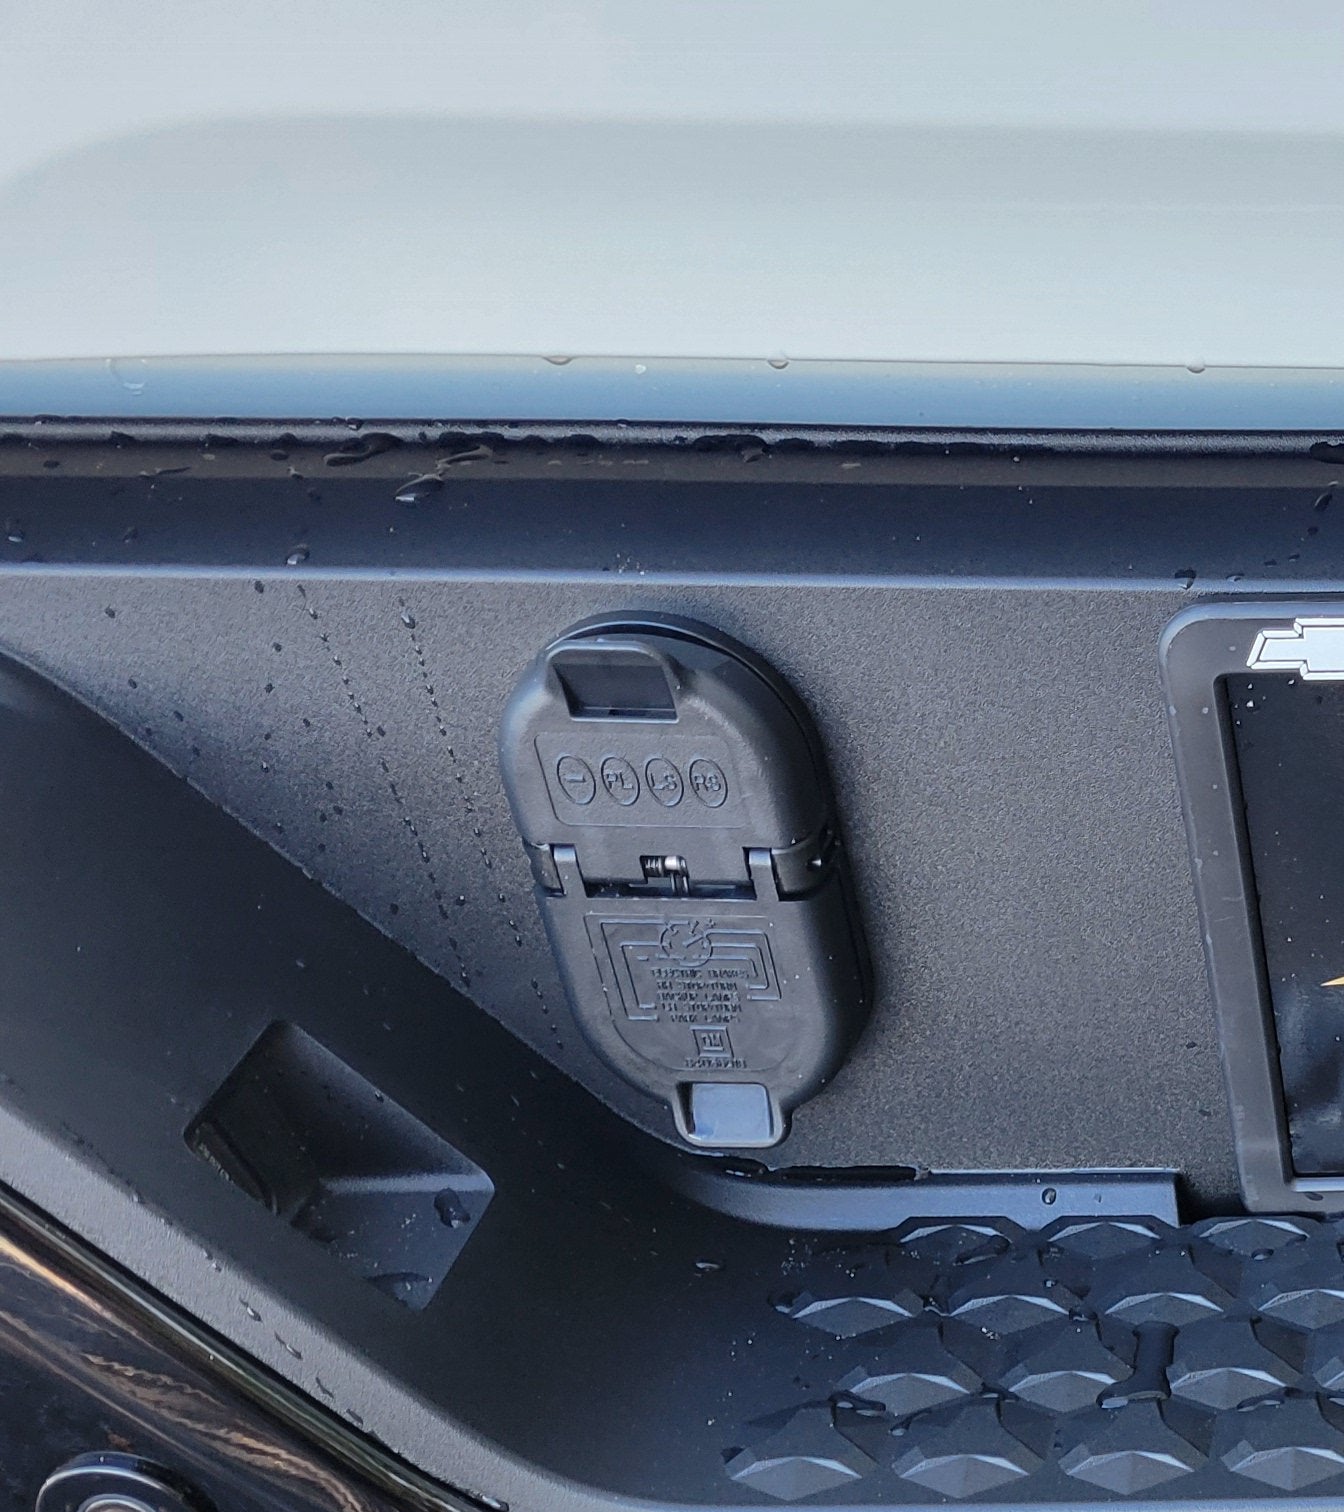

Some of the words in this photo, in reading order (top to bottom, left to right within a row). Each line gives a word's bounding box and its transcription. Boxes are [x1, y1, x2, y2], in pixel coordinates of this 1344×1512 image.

[604, 769, 635, 790] PL
[649, 771, 679, 791] LS
[693, 773, 722, 792] RS
